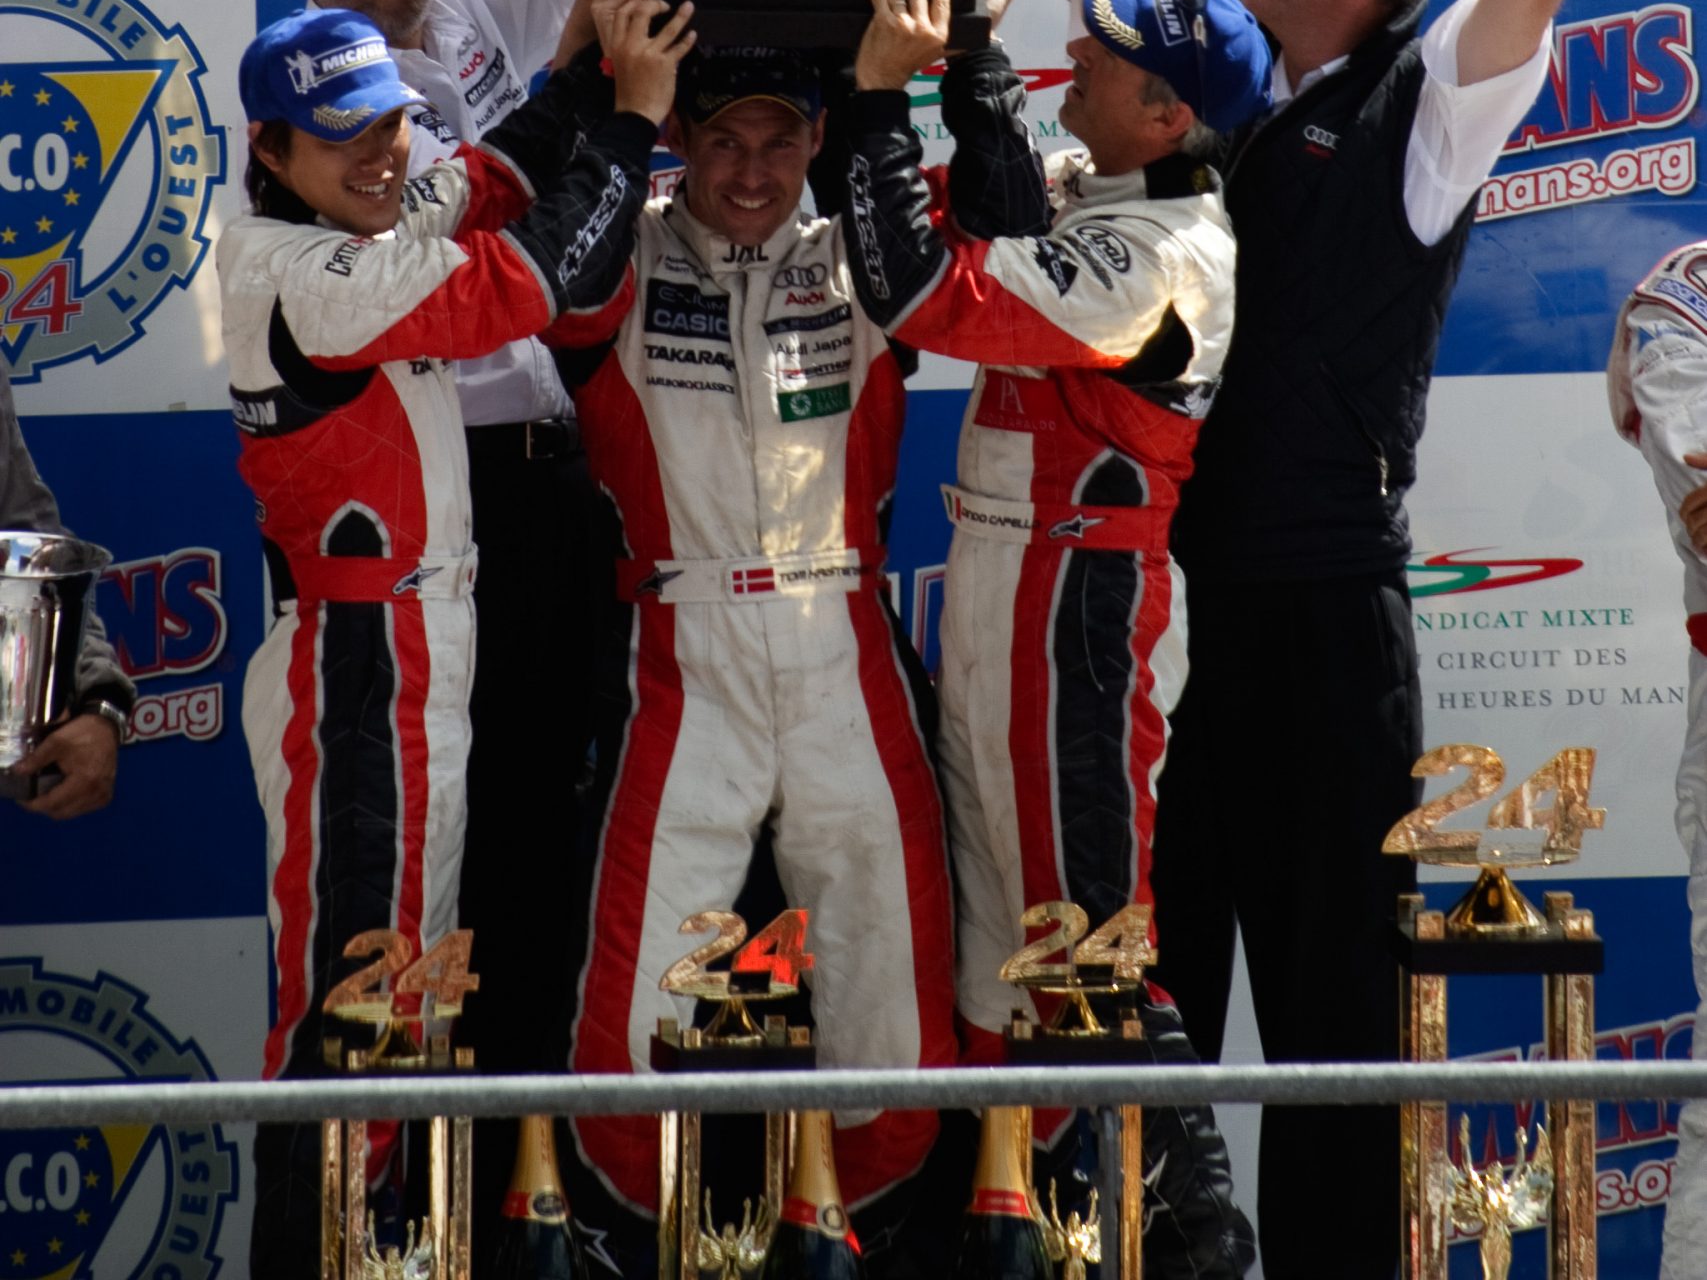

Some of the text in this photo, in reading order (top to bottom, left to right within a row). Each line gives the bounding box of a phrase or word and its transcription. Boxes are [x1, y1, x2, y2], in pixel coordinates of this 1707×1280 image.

[107, 114, 198, 314] L'OUEST
[785, 291, 826, 306] Audi
[644, 344, 728, 366] TAKARA
[812, 335, 852, 354] Japa
[1415, 608, 1635, 631] NDICAT MIXTE
[1437, 648, 1628, 670] CIRCUIT DES
[1437, 686, 1685, 709] HEURES DU MAN
[1381, 743, 1608, 854] 24
[659, 909, 815, 992] 24
[1000, 901, 1158, 982] 24
[323, 929, 480, 1016] 24
